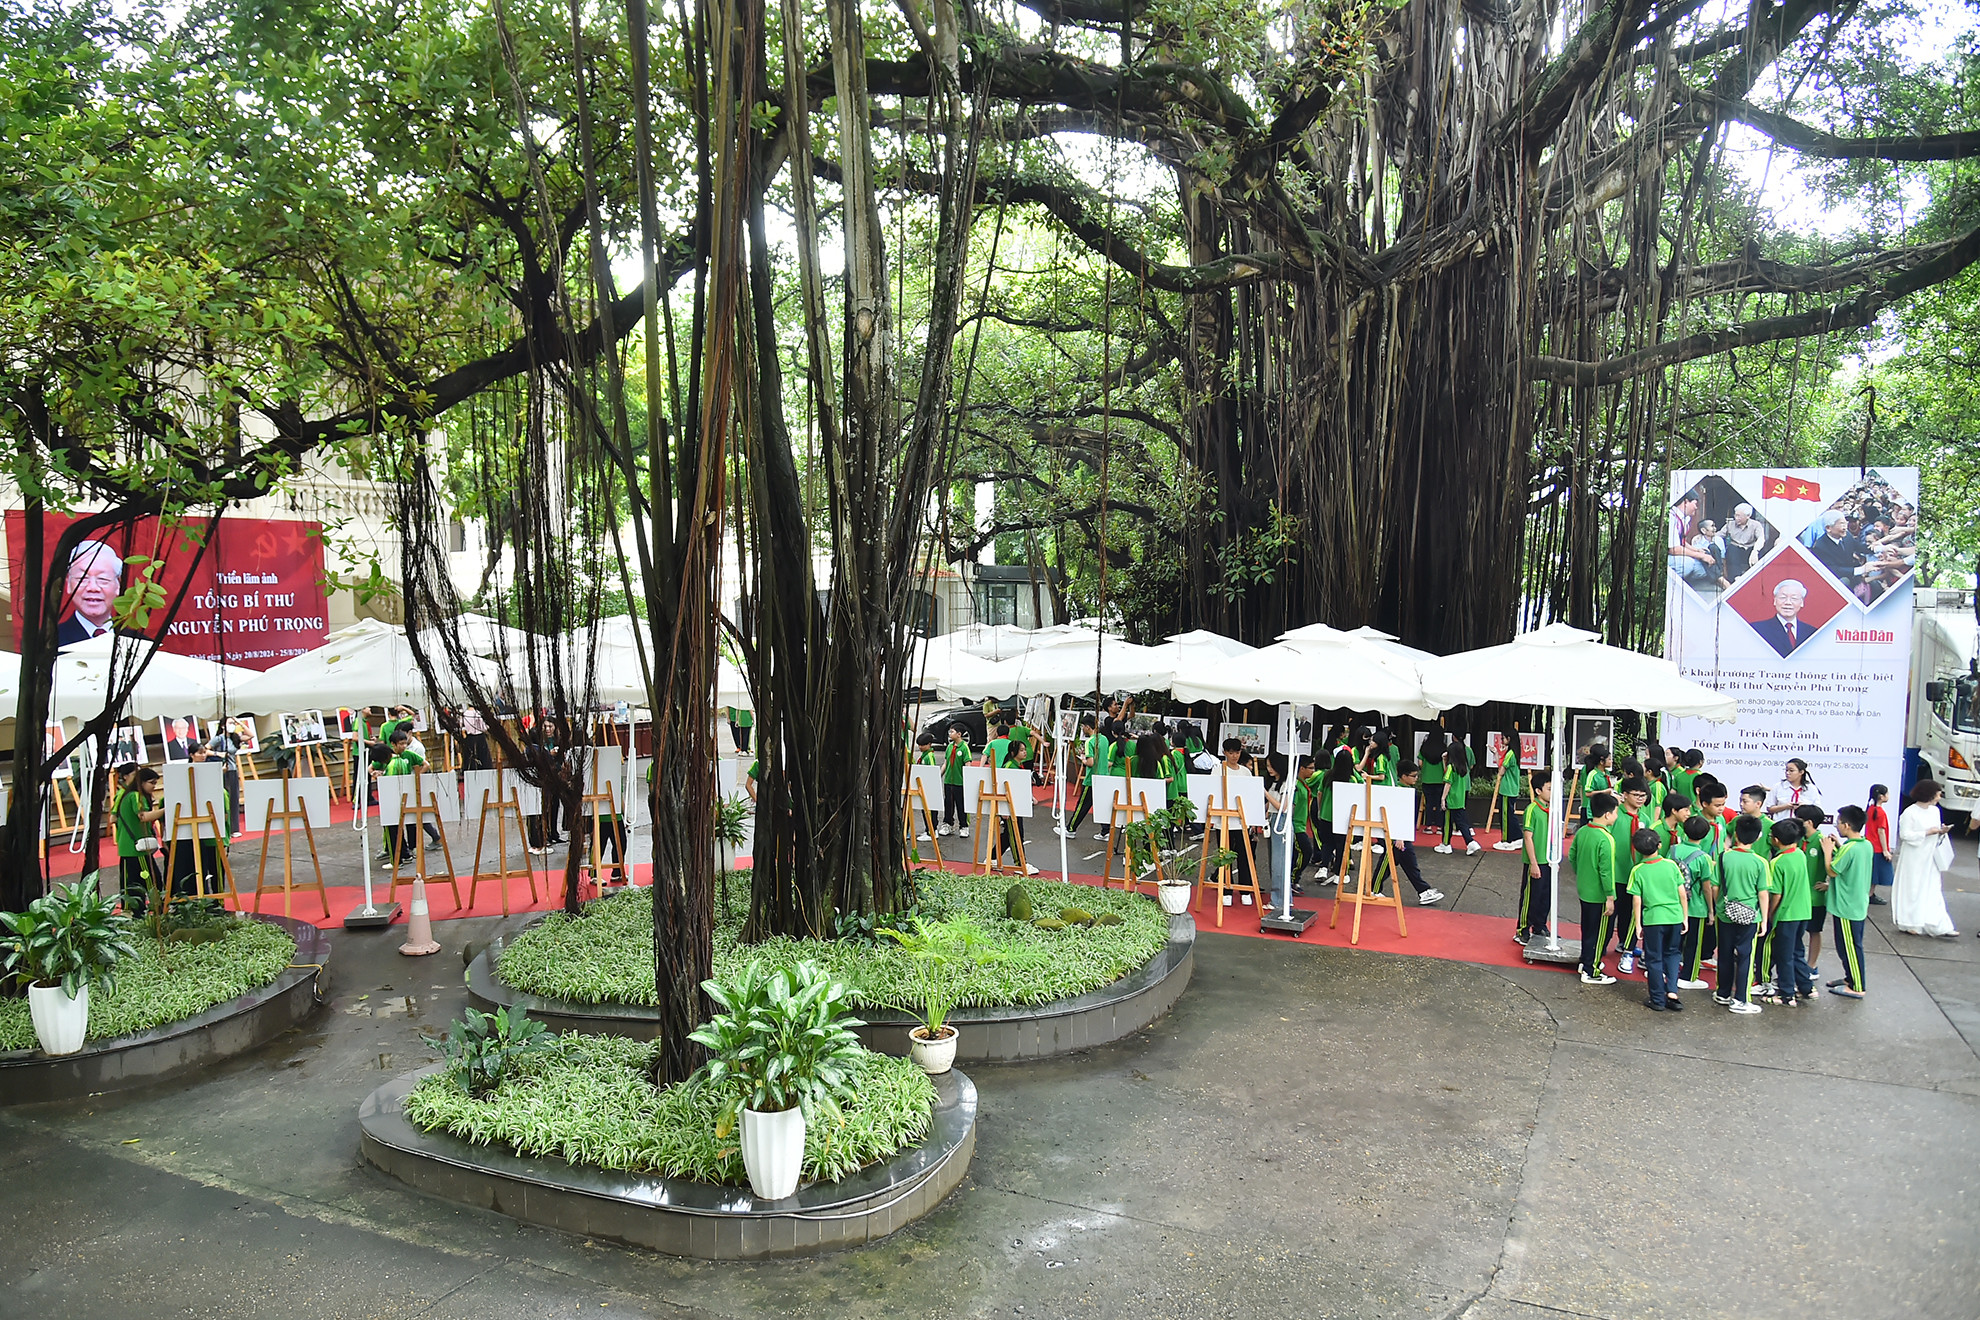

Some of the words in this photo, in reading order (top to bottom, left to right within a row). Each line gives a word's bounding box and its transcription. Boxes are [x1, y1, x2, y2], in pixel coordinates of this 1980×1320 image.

[216, 570, 242, 584] Triển
[243, 572, 260, 584] lãm
[261, 572, 278, 584] ảnh
[193, 588, 238, 609] TỔNG
[243, 590, 260, 608] BÍ
[264, 592, 295, 608] THƯ
[167, 613, 233, 635] NGUYỄN
[239, 615, 269, 633] PHÚ
[273, 617, 323, 633] TRỌNG
[1835, 629, 1868, 642] Nhân
[1869, 630, 1894, 642] Dân
[244, 650, 275, 659] 20/8/2024
[1691, 668, 1714, 677] khai
[1718, 669, 1755, 679] trương
[1759, 670, 1792, 680] Trang
[1795, 671, 1828, 681] thông
[1831, 672, 1847, 681] tin
[1850, 672, 1870, 681] đặc
[1873, 673, 1894, 681] biệt
[1729, 681, 1741, 690] Bí
[1743, 681, 1764, 690] thư
[1766, 682, 1807, 693] Nguyễn
[1810, 683, 1832, 692] Phú
[1836, 683, 1869, 694] Trọng
[1767, 699, 1785, 707] ngày
[1786, 699, 1821, 707] 20/8/2024
[1822, 700, 1840, 708] (Thứ
[1757, 706, 1773, 716] tầng
[1780, 707, 1794, 715] nhà
[1805, 708, 1818, 717] Trụ
[1829, 709, 1844, 717] Báo
[1845, 710, 1865, 718] Nhân
[1866, 710, 1882, 718] Dân
[1738, 728, 1769, 739] Triển
[1773, 730, 1794, 739] lãm
[1797, 731, 1819, 740] ảnh
[1692, 738, 1721, 751] Tổng
[1723, 741, 1735, 750] Bí
[1738, 741, 1760, 751] thư
[1762, 741, 1805, 753] Nguyễn
[1808, 743, 1830, 753] Phú
[1833, 743, 1869, 755] Trọng
[1726, 758, 1743, 766] 9h30
[1744, 760, 1762, 768] ngày
[1833, 762, 1869, 770] 25/8/2024
